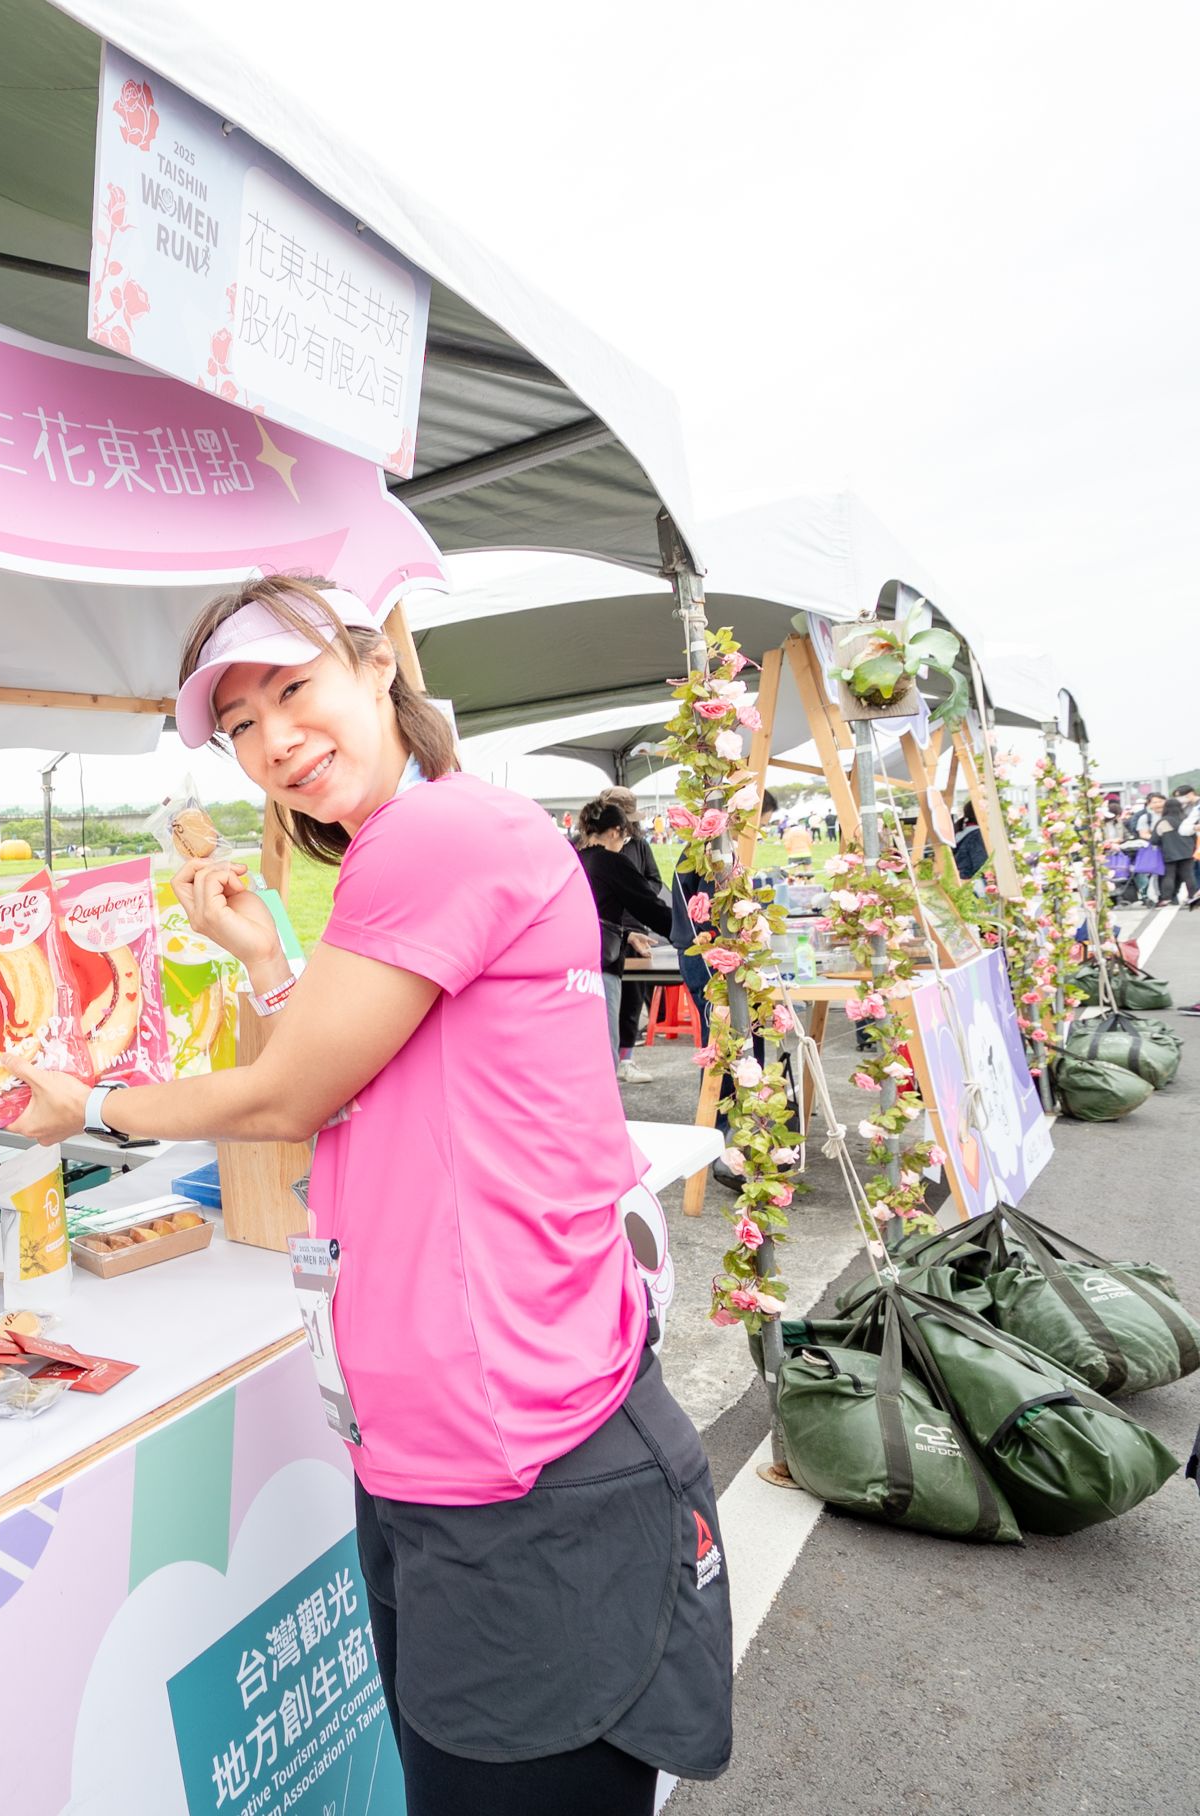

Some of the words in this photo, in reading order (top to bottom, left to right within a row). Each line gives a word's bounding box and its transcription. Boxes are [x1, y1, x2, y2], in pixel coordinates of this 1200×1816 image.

[157, 153, 208, 202] TAISHIN
[174, 141, 196, 166] 2025
[141, 172, 219, 249] WOMEN
[156, 222, 201, 274] RUN
[245, 211, 410, 356] 花東共生共好
[238, 287, 403, 418] 股份有限公司
[68, 893, 148, 926] Raspberry
[915, 1443, 937, 1453] BIG
[236, 1568, 357, 1711] 台灣觀光
[271, 1738, 318, 1791] Tourism
[319, 1712, 340, 1744] and
[283, 1737, 345, 1813] Association
[345, 1728, 357, 1747] in
[356, 1695, 386, 1733] Taiwa
